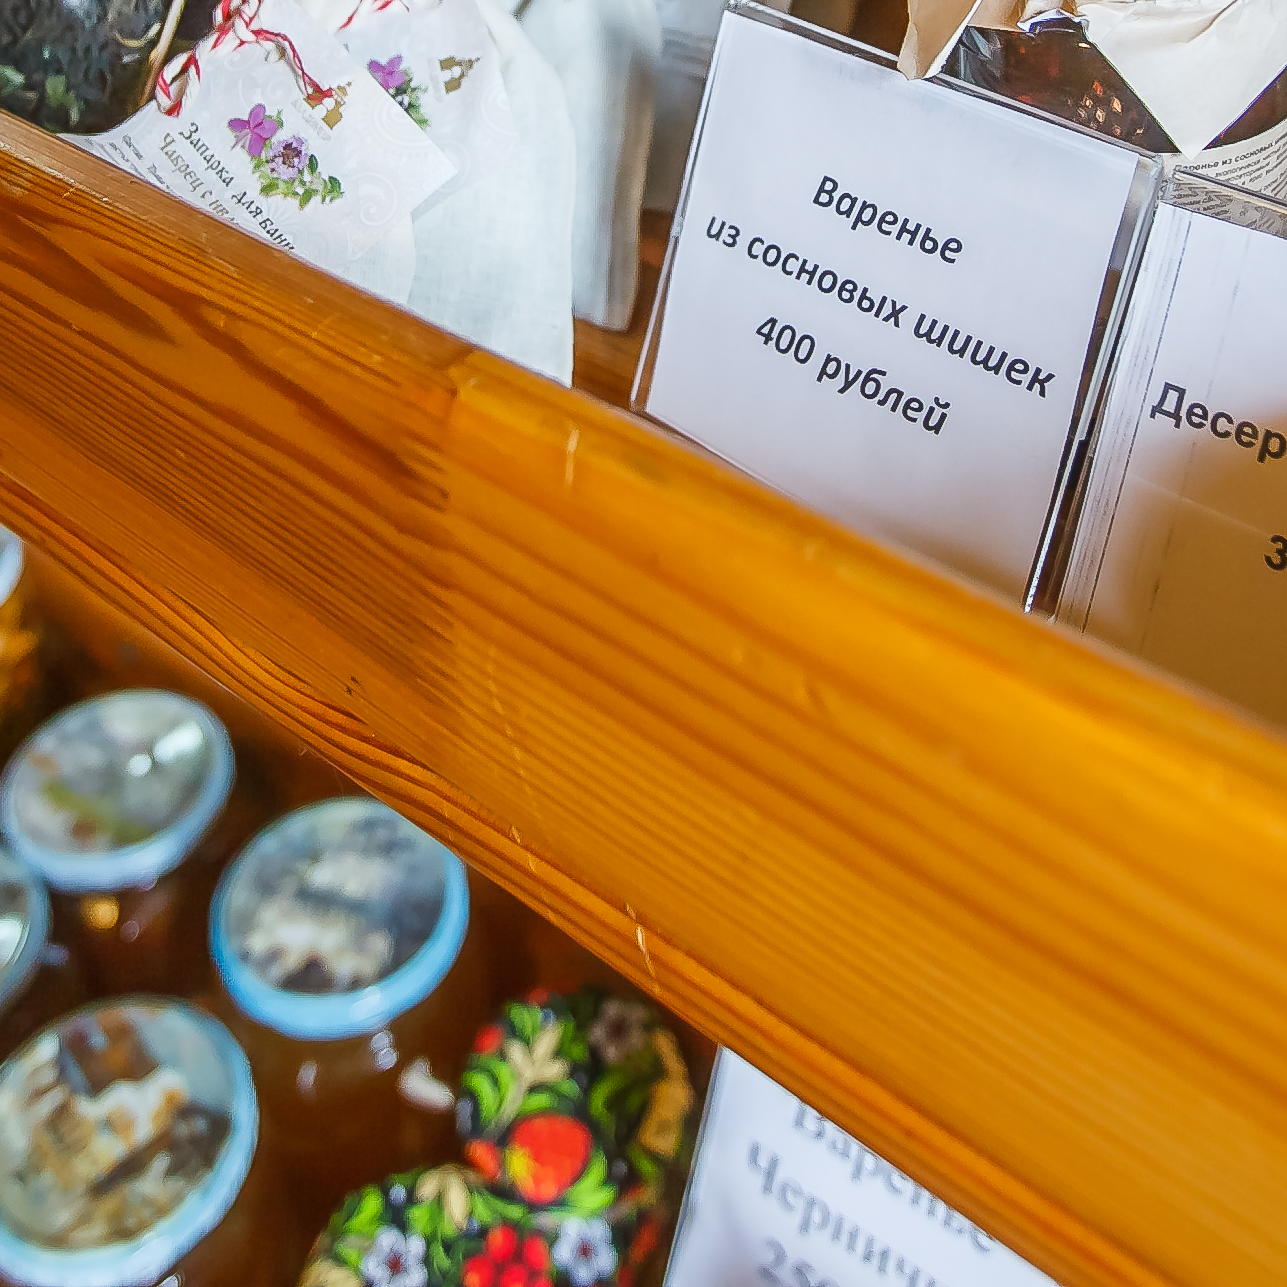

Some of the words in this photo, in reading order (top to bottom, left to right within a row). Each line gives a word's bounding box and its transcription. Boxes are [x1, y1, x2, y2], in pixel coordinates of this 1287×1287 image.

[158, 131, 205, 193] Чабрец
[177, 120, 236, 188] Запарка
[811, 174, 964, 265] Варенье
[705, 213, 741, 249] из
[746, 234, 909, 329] сосновых
[913, 312, 1056, 399] шишек
[755, 314, 817, 365] 400
[816, 352, 951, 436] рублей
